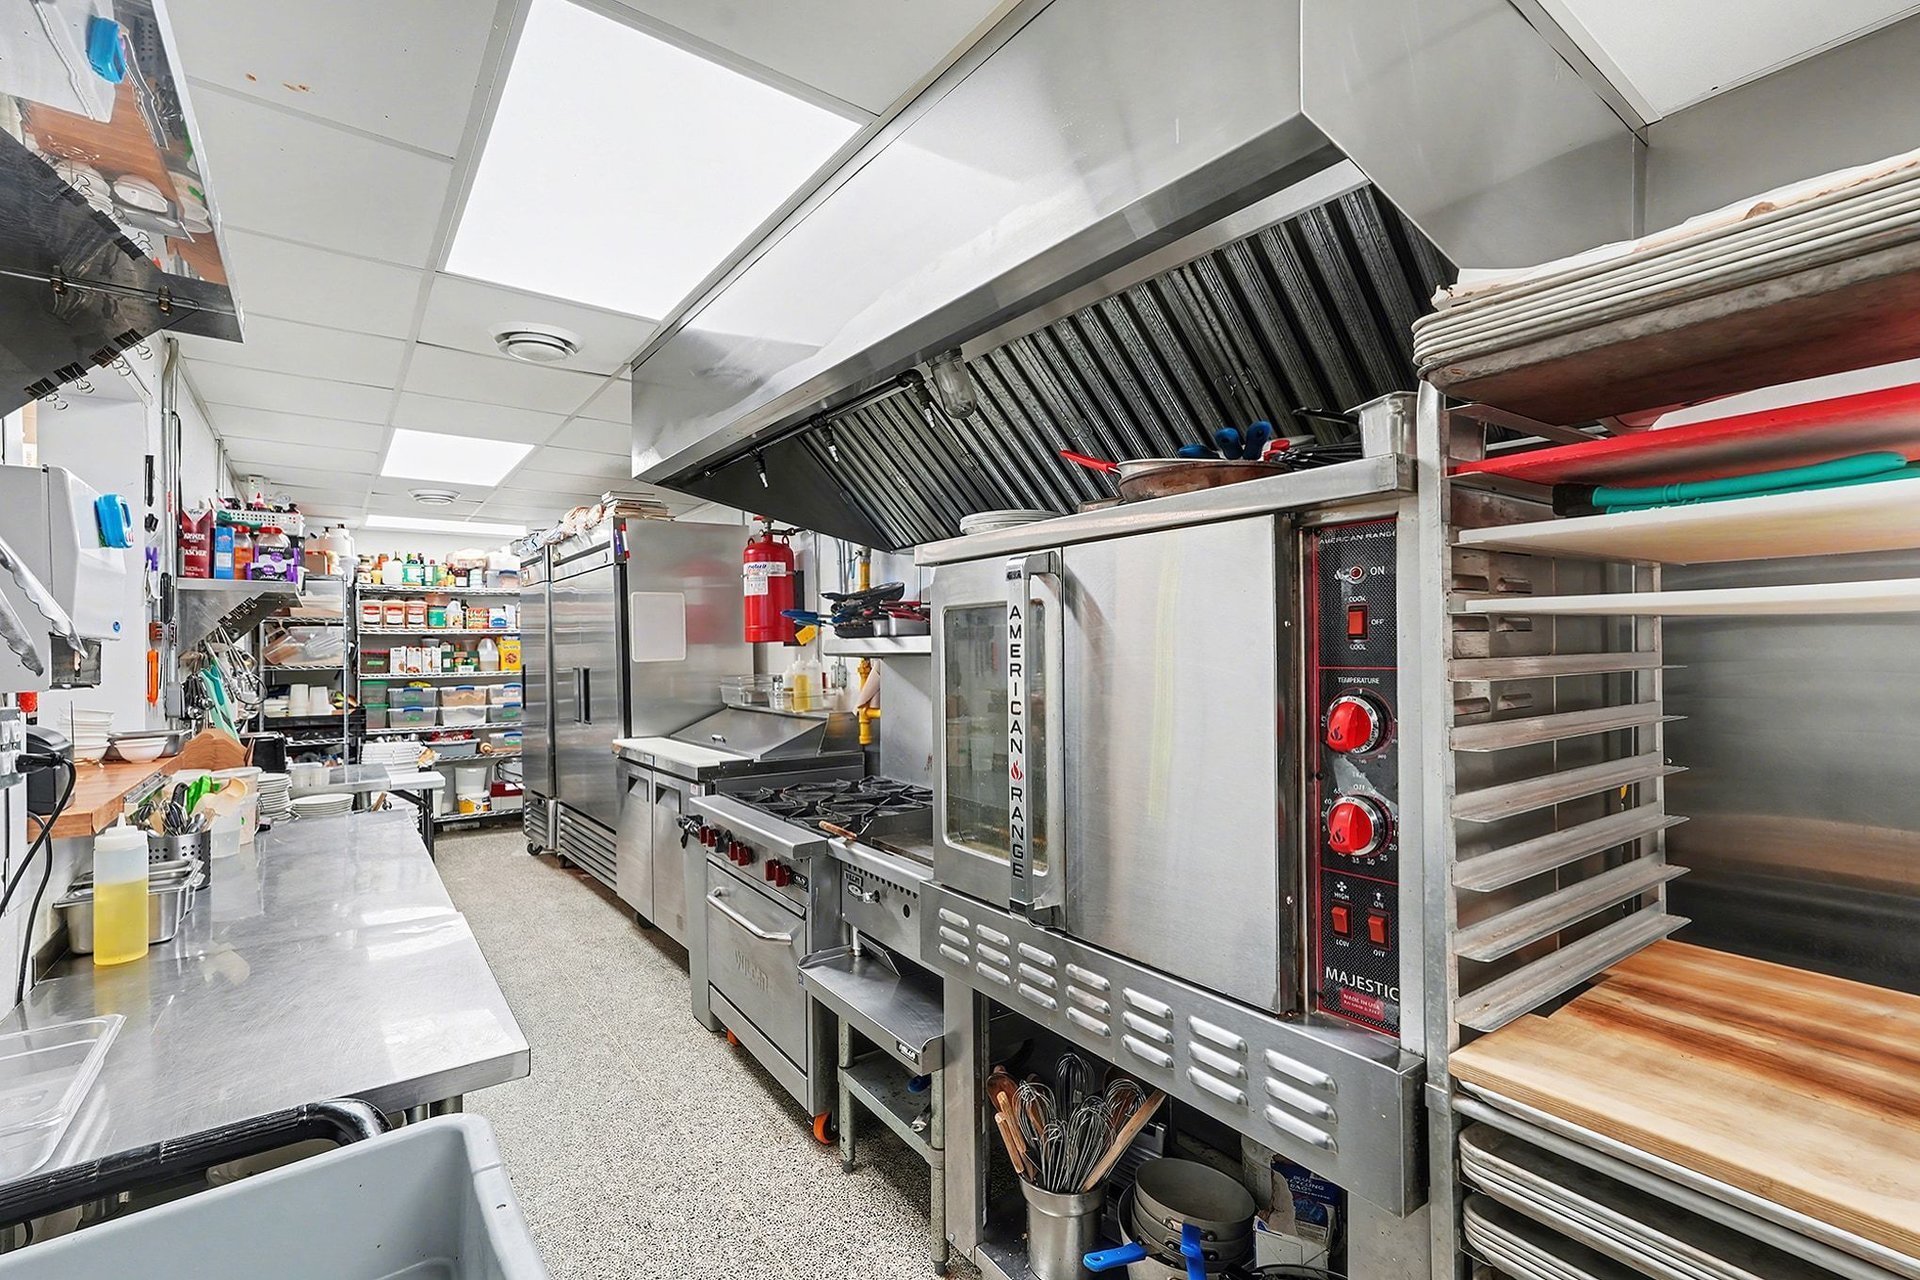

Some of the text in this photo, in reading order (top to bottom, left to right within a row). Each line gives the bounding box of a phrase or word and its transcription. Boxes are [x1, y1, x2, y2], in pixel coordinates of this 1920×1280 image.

[1319, 534, 1364, 544] AMERICAN
[1370, 565, 1385, 576] ON
[1337, 676, 1380, 684] TEMPERATURE
[1009, 605, 1025, 879] AMERICAN RANGE
[1334, 891, 1350, 900] HIGH
[1373, 900, 1384, 909] ON
[1335, 939, 1350, 948] LOW
[1325, 966, 1399, 1002] MAJESTIC
